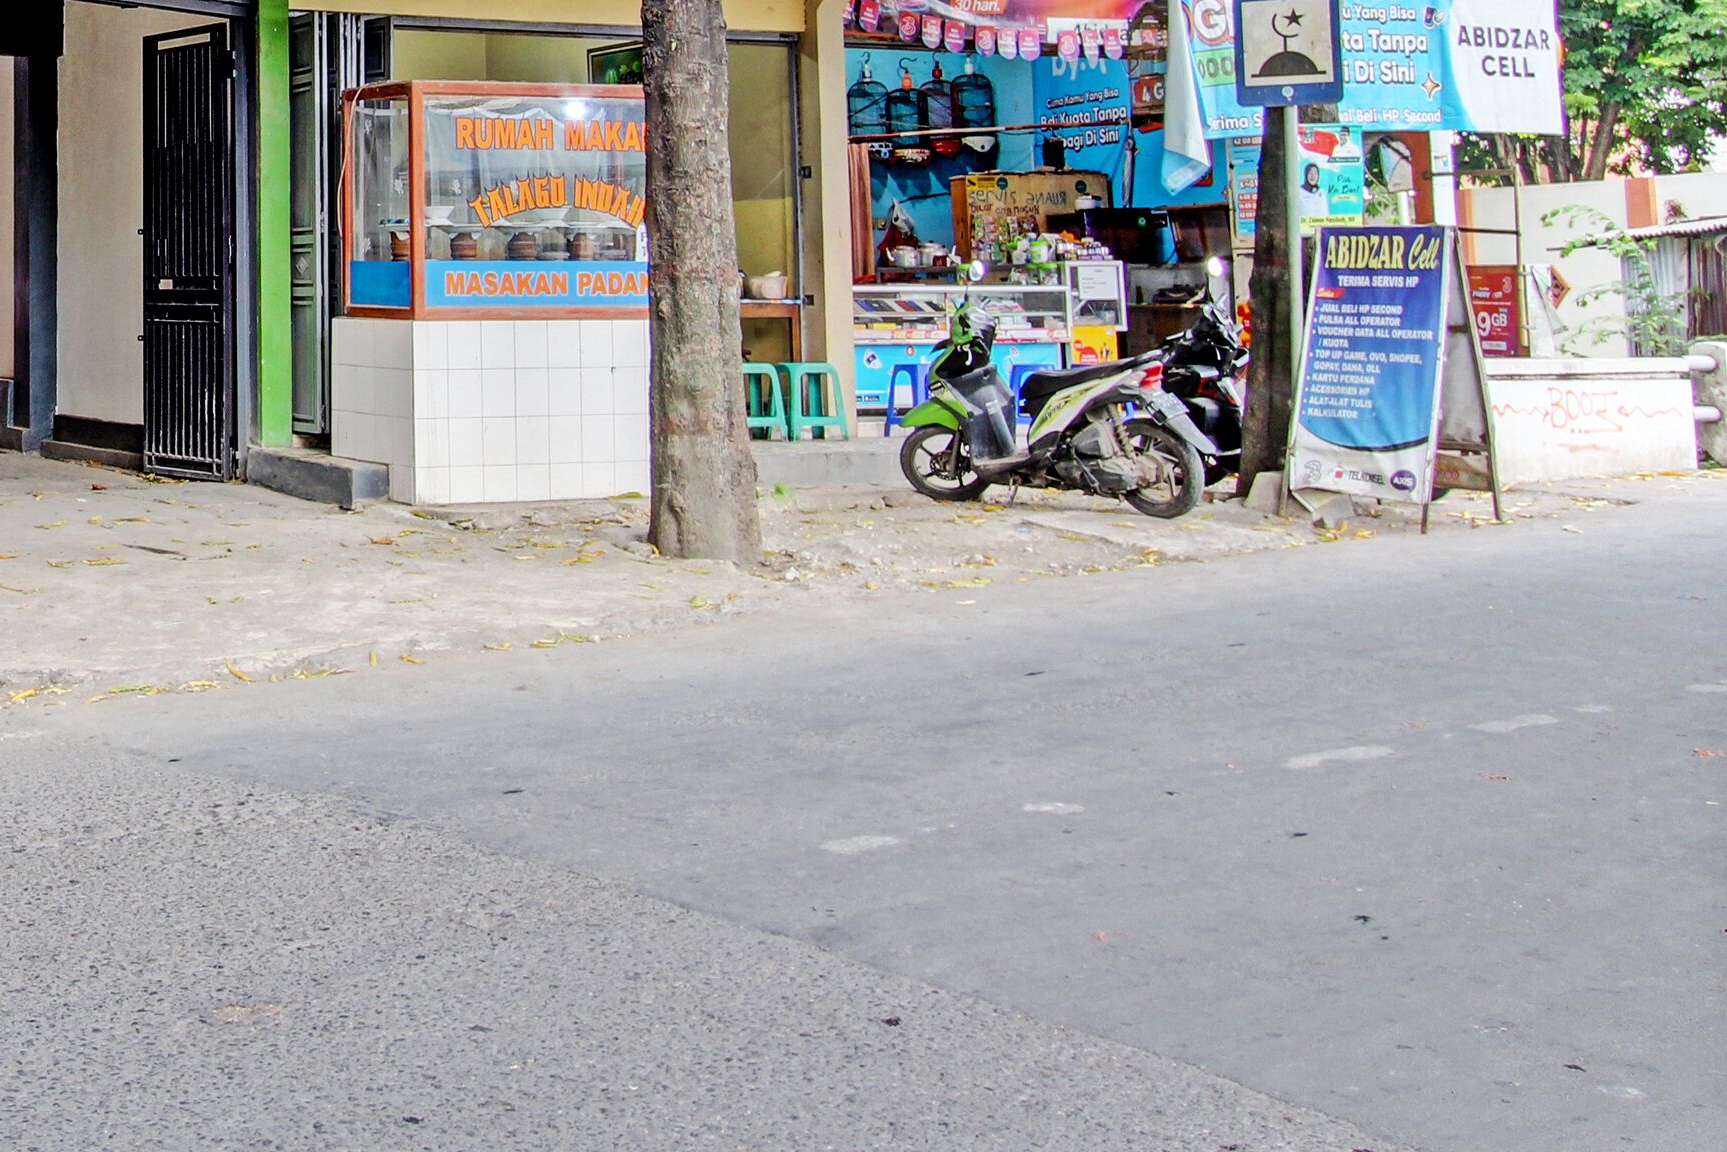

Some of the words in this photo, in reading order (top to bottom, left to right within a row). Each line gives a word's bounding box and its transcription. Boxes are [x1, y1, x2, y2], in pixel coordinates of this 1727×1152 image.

[1354, 5, 1387, 24] Yang
[1389, 5, 1417, 21] Bisa
[1367, 29, 1429, 57] Tanpa
[1457, 25, 1550, 50] ABIDZAR
[1354, 61, 1378, 84] Di
[1380, 61, 1416, 84] Sini
[1481, 55, 1535, 78] CELL
[1092, 106, 1127, 123] Tanpa
[1356, 108, 1378, 122] Beli
[1404, 108, 1442, 123] Second
[455, 117, 554, 151] RUMAH
[1085, 130, 1097, 146] Di
[1099, 127, 1120, 144] Sini
[468, 172, 566, 229] TALAGO
[1324, 235, 1405, 270] ABIDZAR
[1408, 233, 1440, 270] Cell
[445, 271, 568, 296] MASAKAN
[1337, 275, 1370, 287] TERIMA
[1372, 275, 1404, 288] SERVIS
[1405, 276, 1420, 288] HP
[1320, 303, 1340, 313] JUAL
[1341, 304, 1357, 313] BELI
[1359, 304, 1369, 313] HP
[1371, 304, 1403, 315] SECOND
[1319, 315, 1343, 325] PULSA
[1344, 316, 1359, 325] ALL
[1360, 316, 1401, 326] OPERATOR
[1317, 327, 1354, 337] VOUCHER
[1355, 328, 1374, 338] DATA
[1375, 328, 1390, 338] ALL
[1391, 329, 1433, 340] OPERATOR
[1323, 339, 1349, 348] KUOTA
[1315, 350, 1330, 359] TOP
[1331, 350, 1343, 359] UP
[1312, 373, 1338, 383] KARTU
